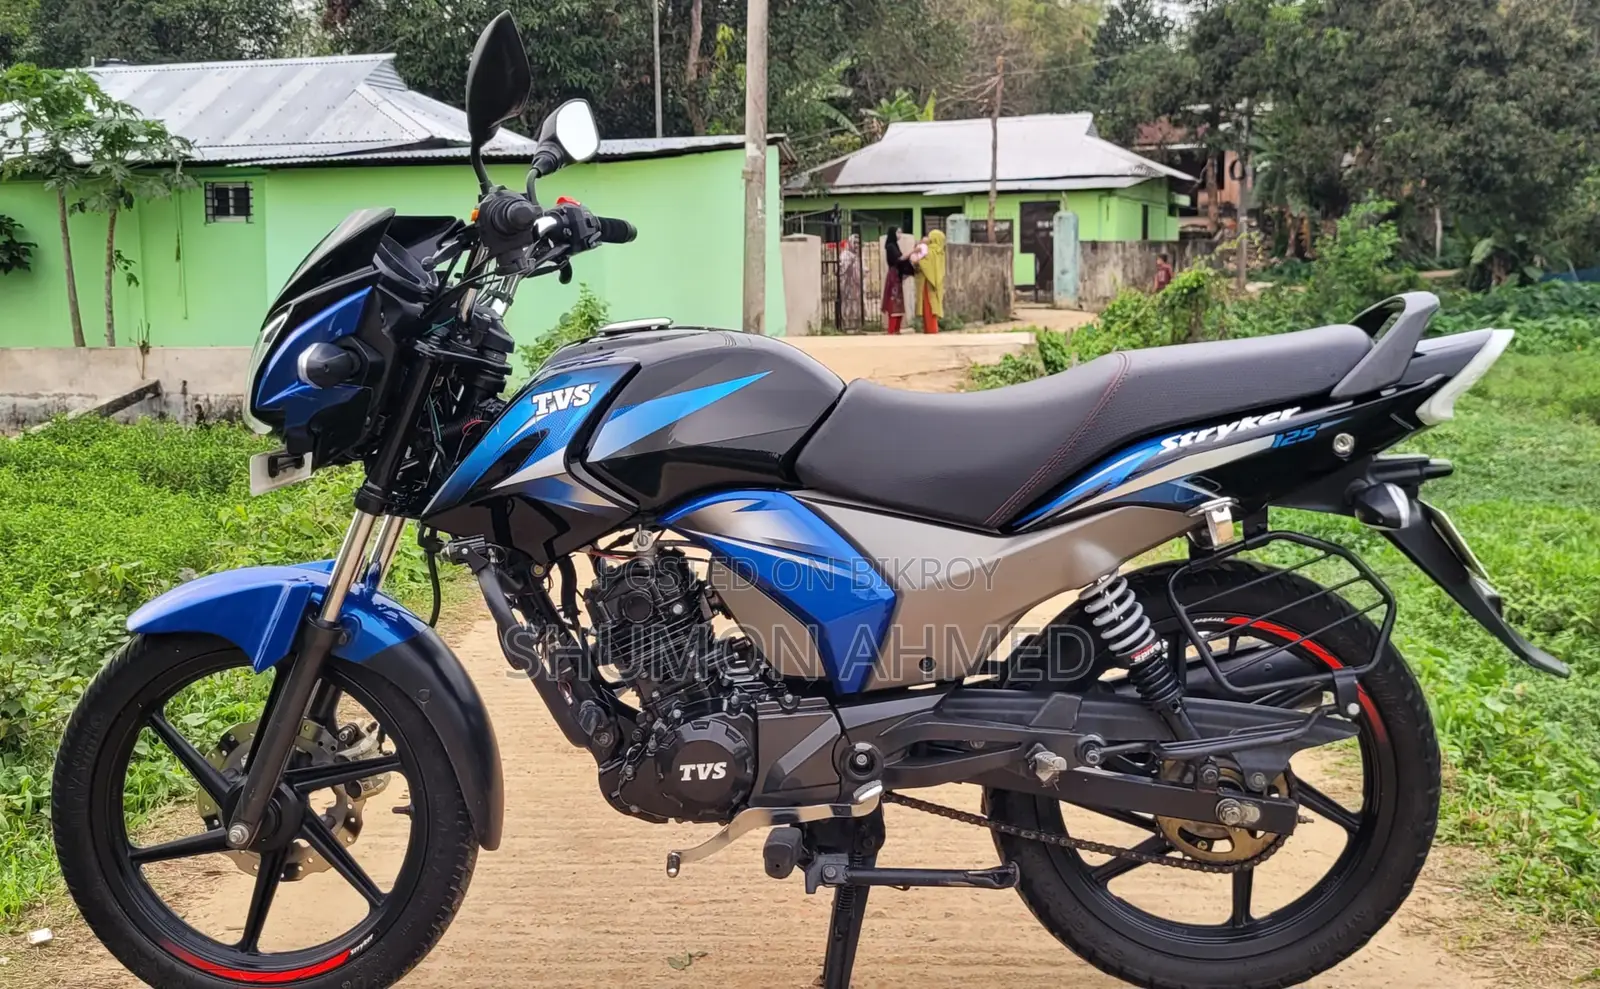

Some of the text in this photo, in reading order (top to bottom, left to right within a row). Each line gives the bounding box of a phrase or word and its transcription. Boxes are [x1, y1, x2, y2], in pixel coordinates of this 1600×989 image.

[532, 382, 593, 416] TVS
[1157, 406, 1322, 455] Stryker 125
[679, 761, 728, 781] TVS
